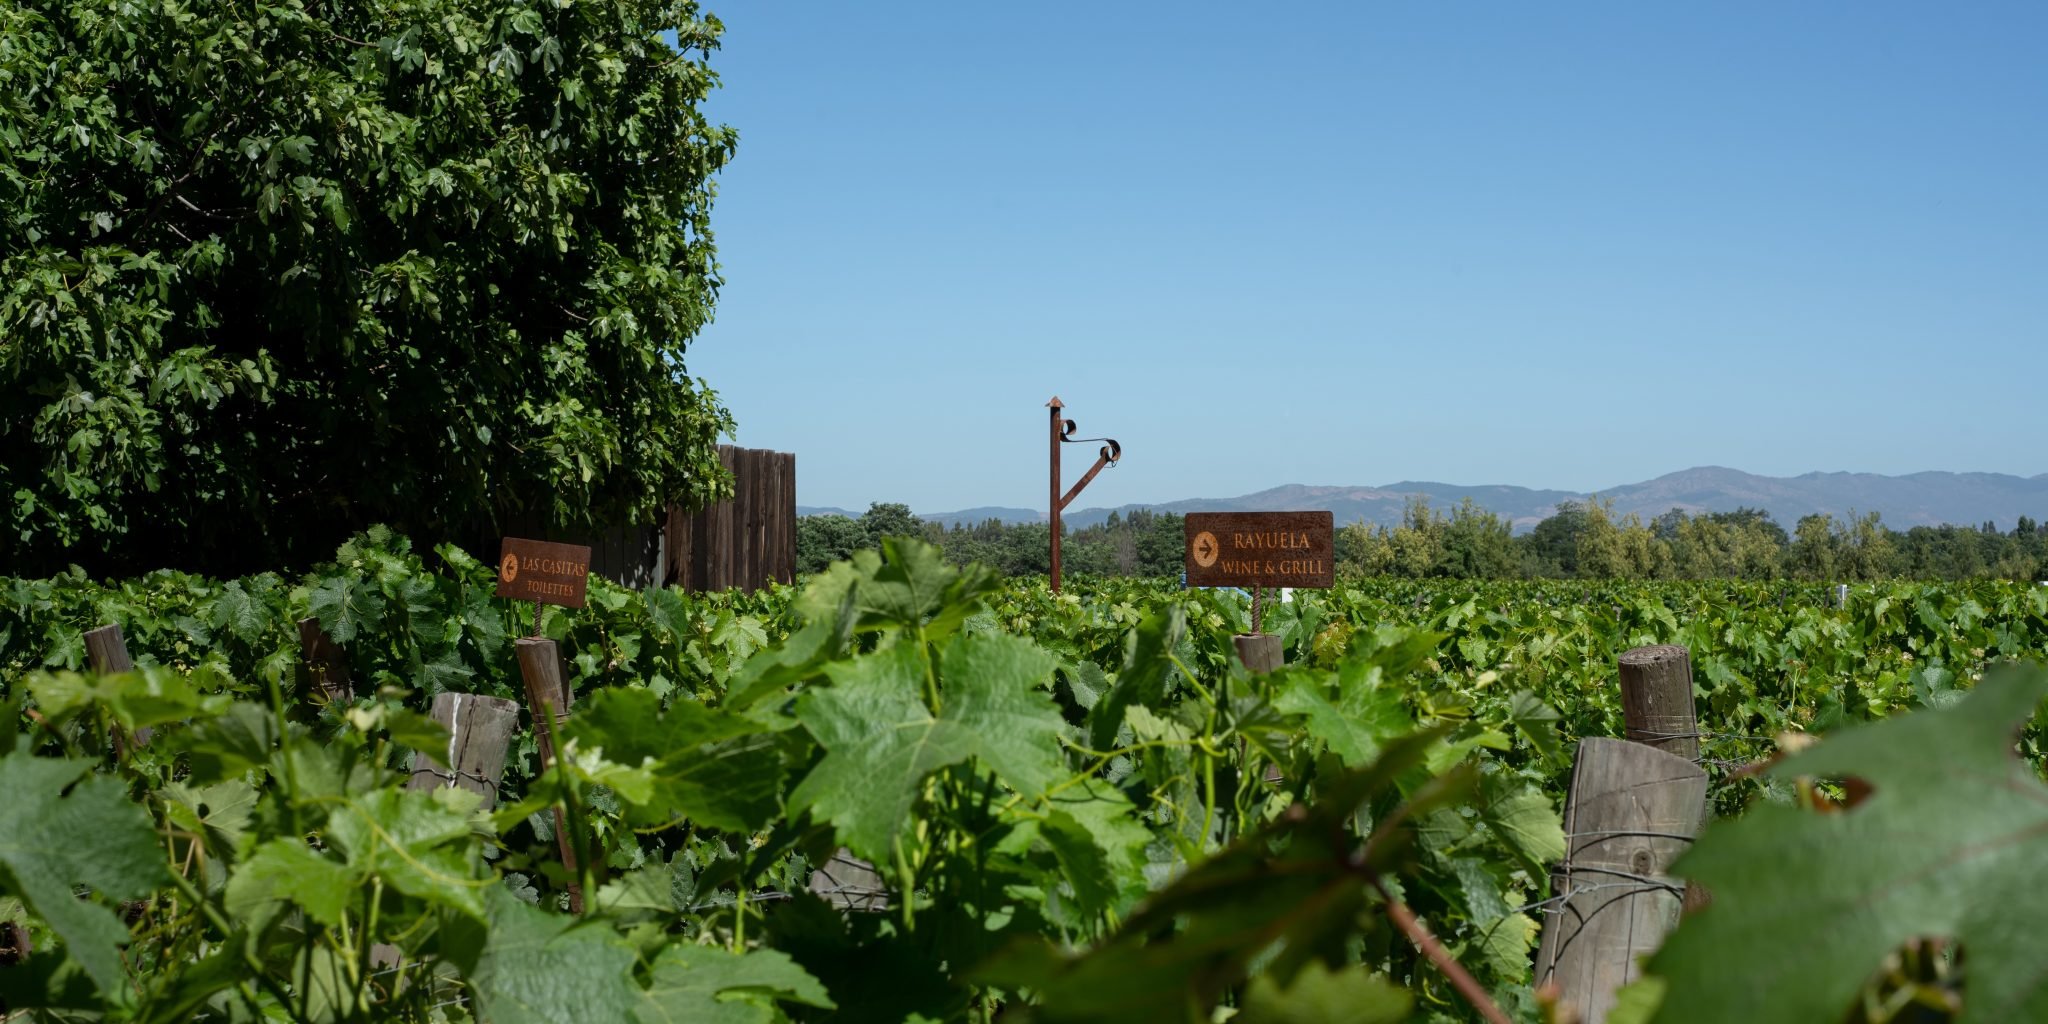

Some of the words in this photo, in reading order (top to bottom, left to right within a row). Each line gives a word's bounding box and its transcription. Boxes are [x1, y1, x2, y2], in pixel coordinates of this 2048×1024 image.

[1235, 532, 1310, 549] RAYUELA
[522, 557, 540, 571] LAS
[542, 559, 585, 577] CASITAS
[1222, 560, 1260, 574] WINE
[1265, 561, 1275, 574] &
[1280, 560, 1325, 574] GRILL
[527, 580, 573, 597] TOILETTES
